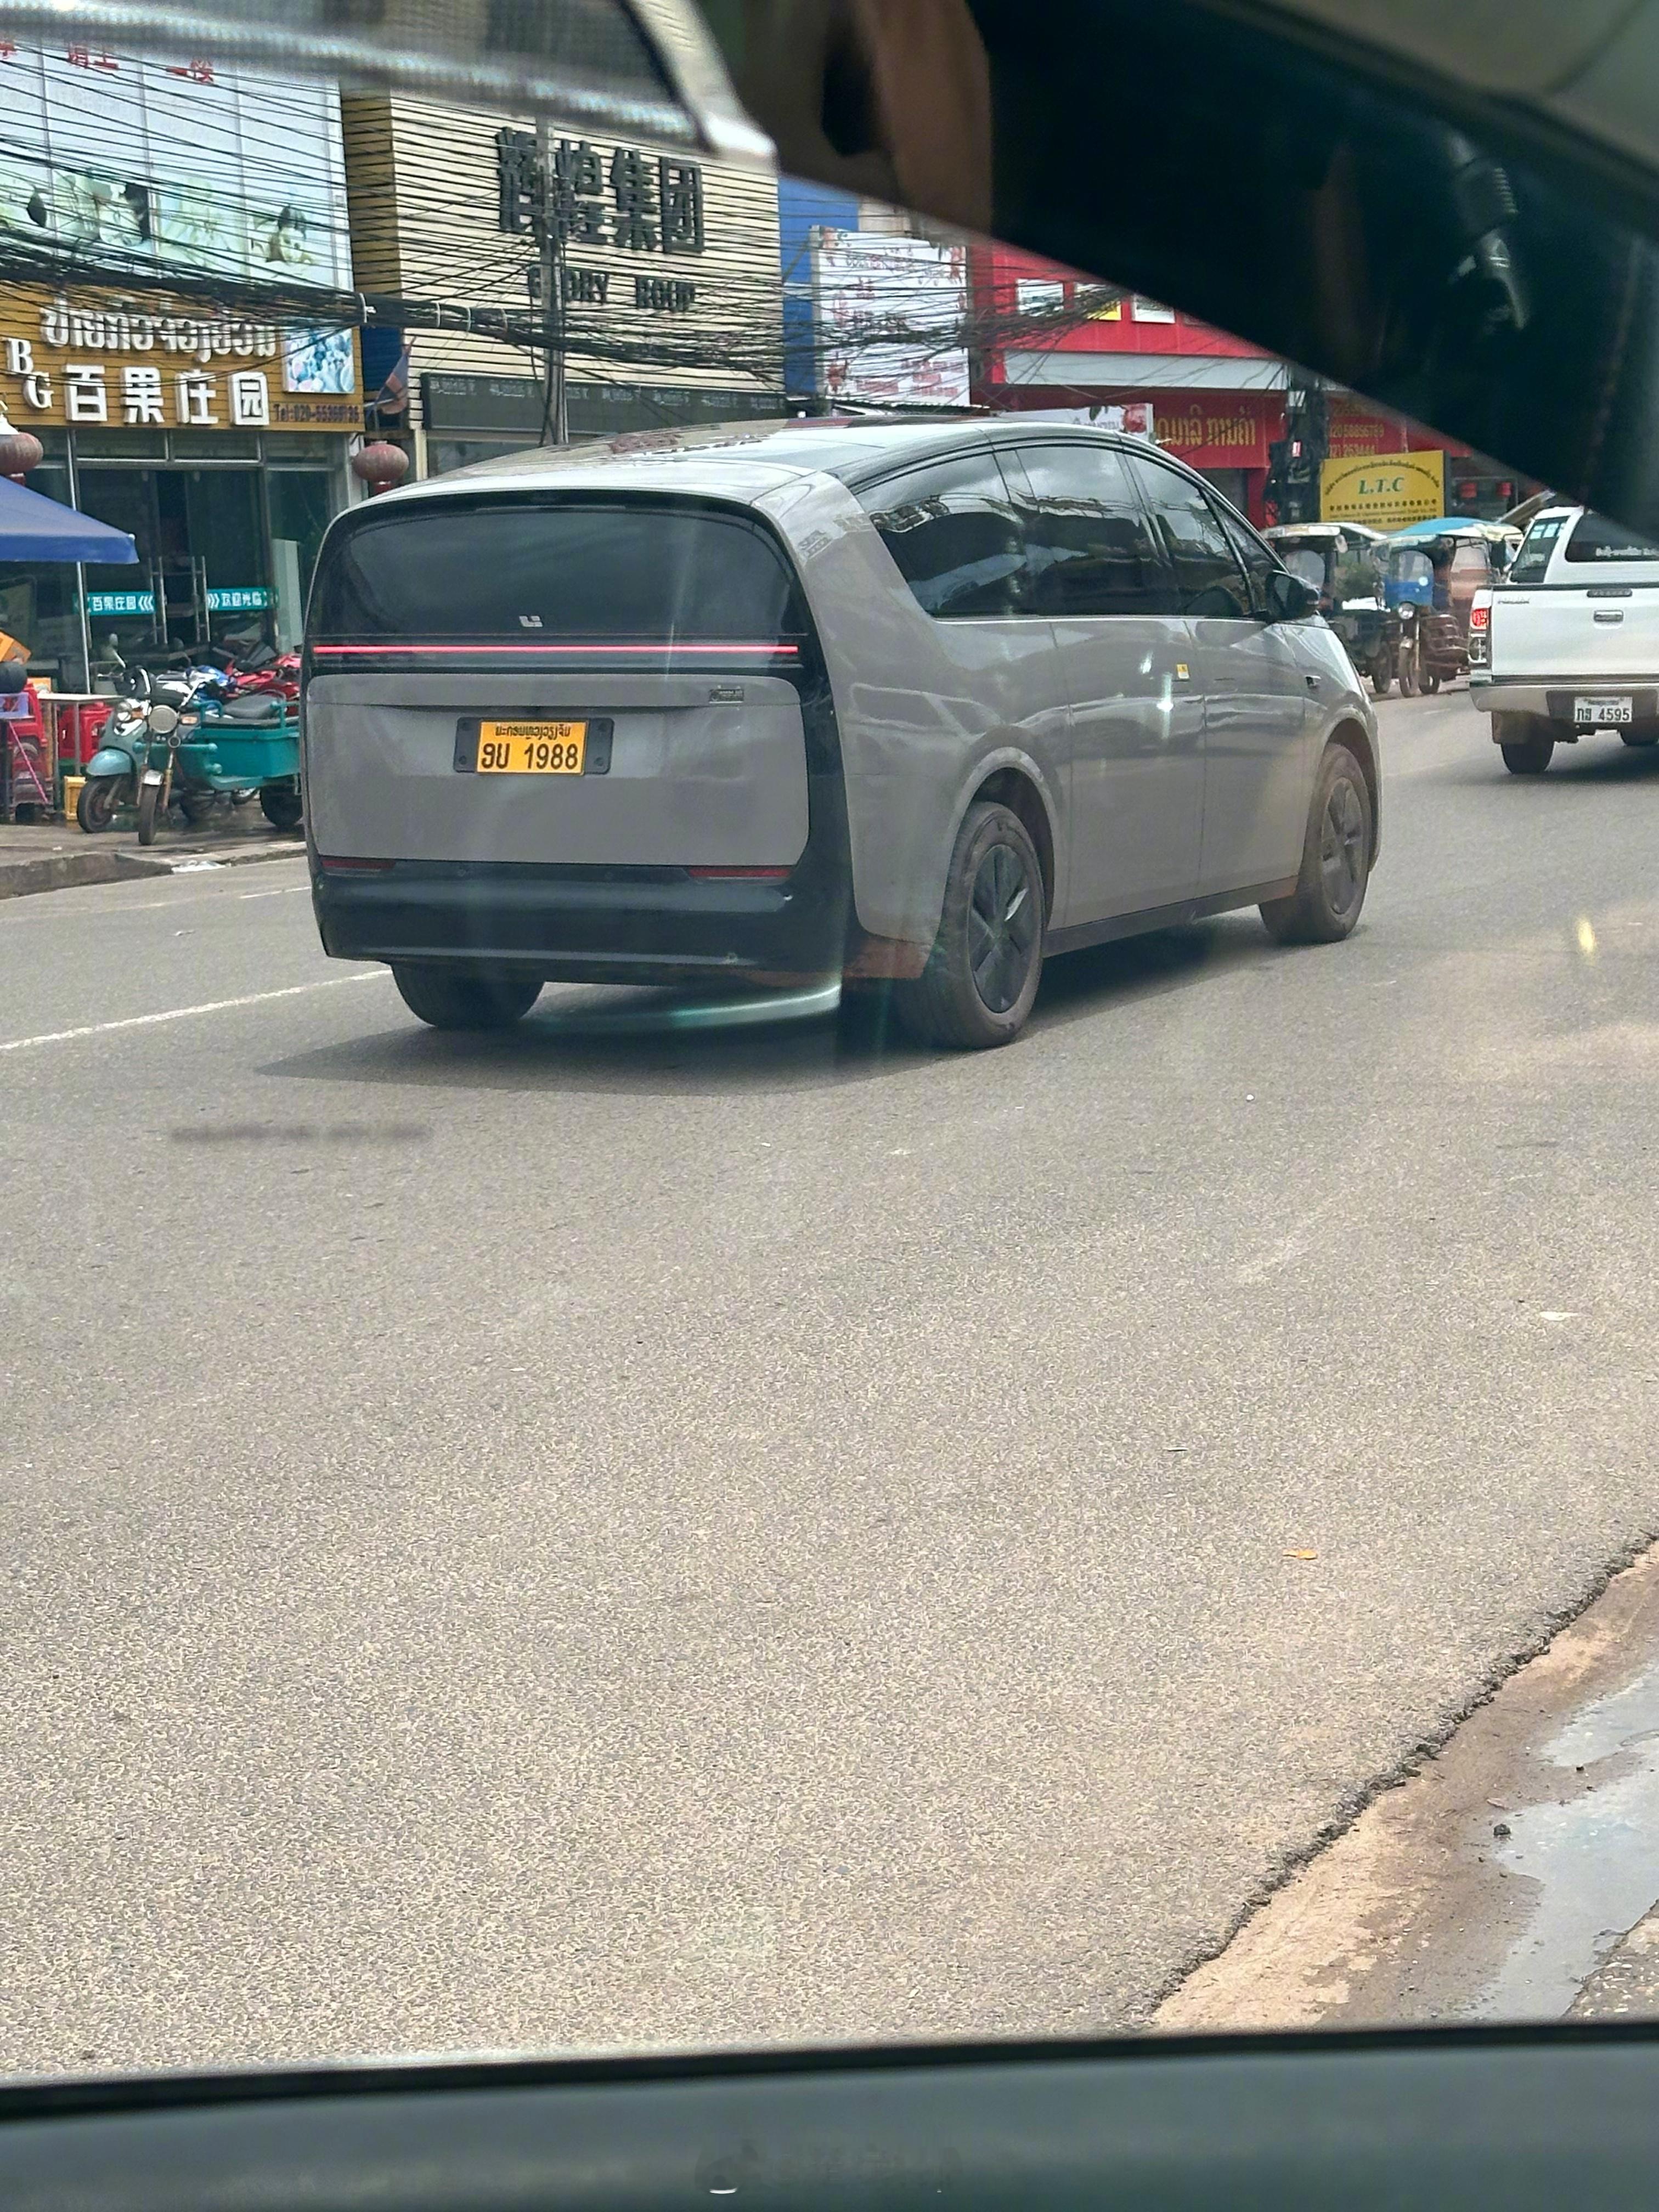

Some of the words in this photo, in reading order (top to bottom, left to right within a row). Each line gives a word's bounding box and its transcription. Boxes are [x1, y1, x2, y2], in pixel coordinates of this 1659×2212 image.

[61, 363, 270, 427] 百果庄园
[1358, 476, 1405, 495] L.T.C
[1598, 708, 1630, 721] 4595
[524, 743, 578, 770] 1988
